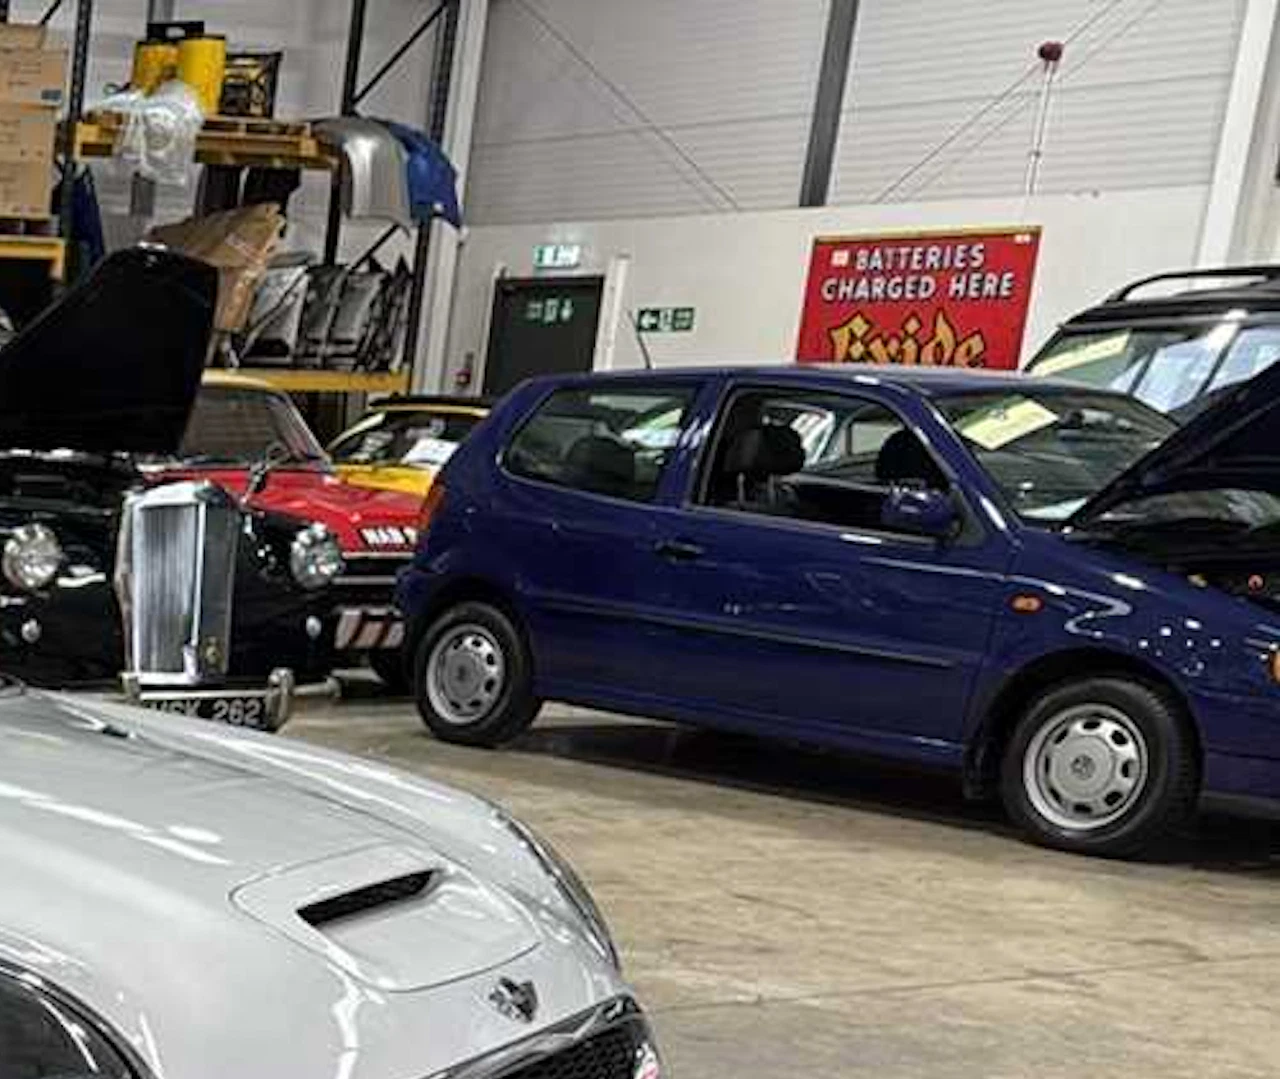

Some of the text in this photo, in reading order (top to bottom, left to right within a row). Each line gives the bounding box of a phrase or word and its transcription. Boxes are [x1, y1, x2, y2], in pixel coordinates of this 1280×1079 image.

[854, 243, 986, 271] BATTERIES
[821, 271, 1015, 301] CHARGED HERE
[212, 699, 262, 726] 262
